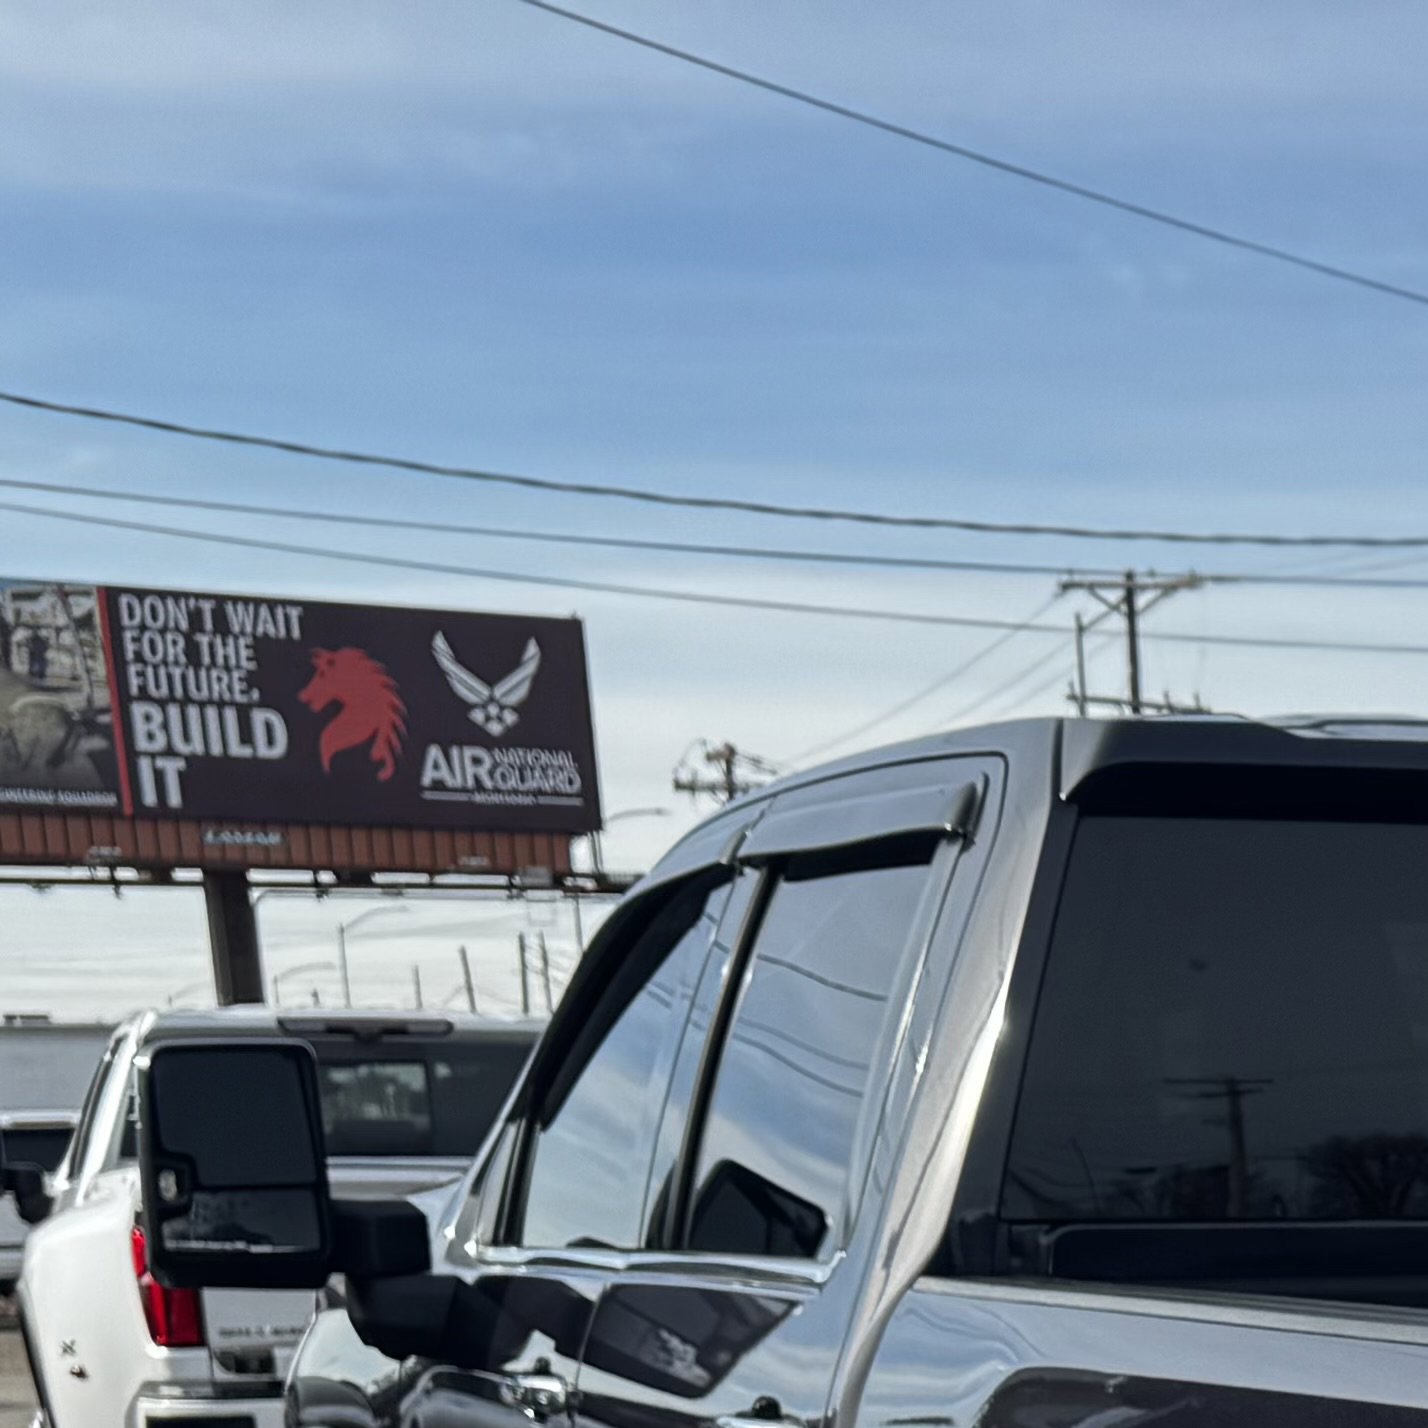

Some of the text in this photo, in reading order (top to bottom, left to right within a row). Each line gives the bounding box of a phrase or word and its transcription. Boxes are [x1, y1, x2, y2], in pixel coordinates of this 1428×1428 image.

[118, 593, 303, 640] DON'T WAIT
[122, 629, 257, 670] FOR THE
[126, 663, 260, 703] FUTURE.
[130, 700, 288, 759] BUILD
[420, 744, 493, 790] AIR
[494, 747, 578, 768] NATIONAL
[137, 755, 186, 808] IT
[494, 765, 582, 794] GUARD
